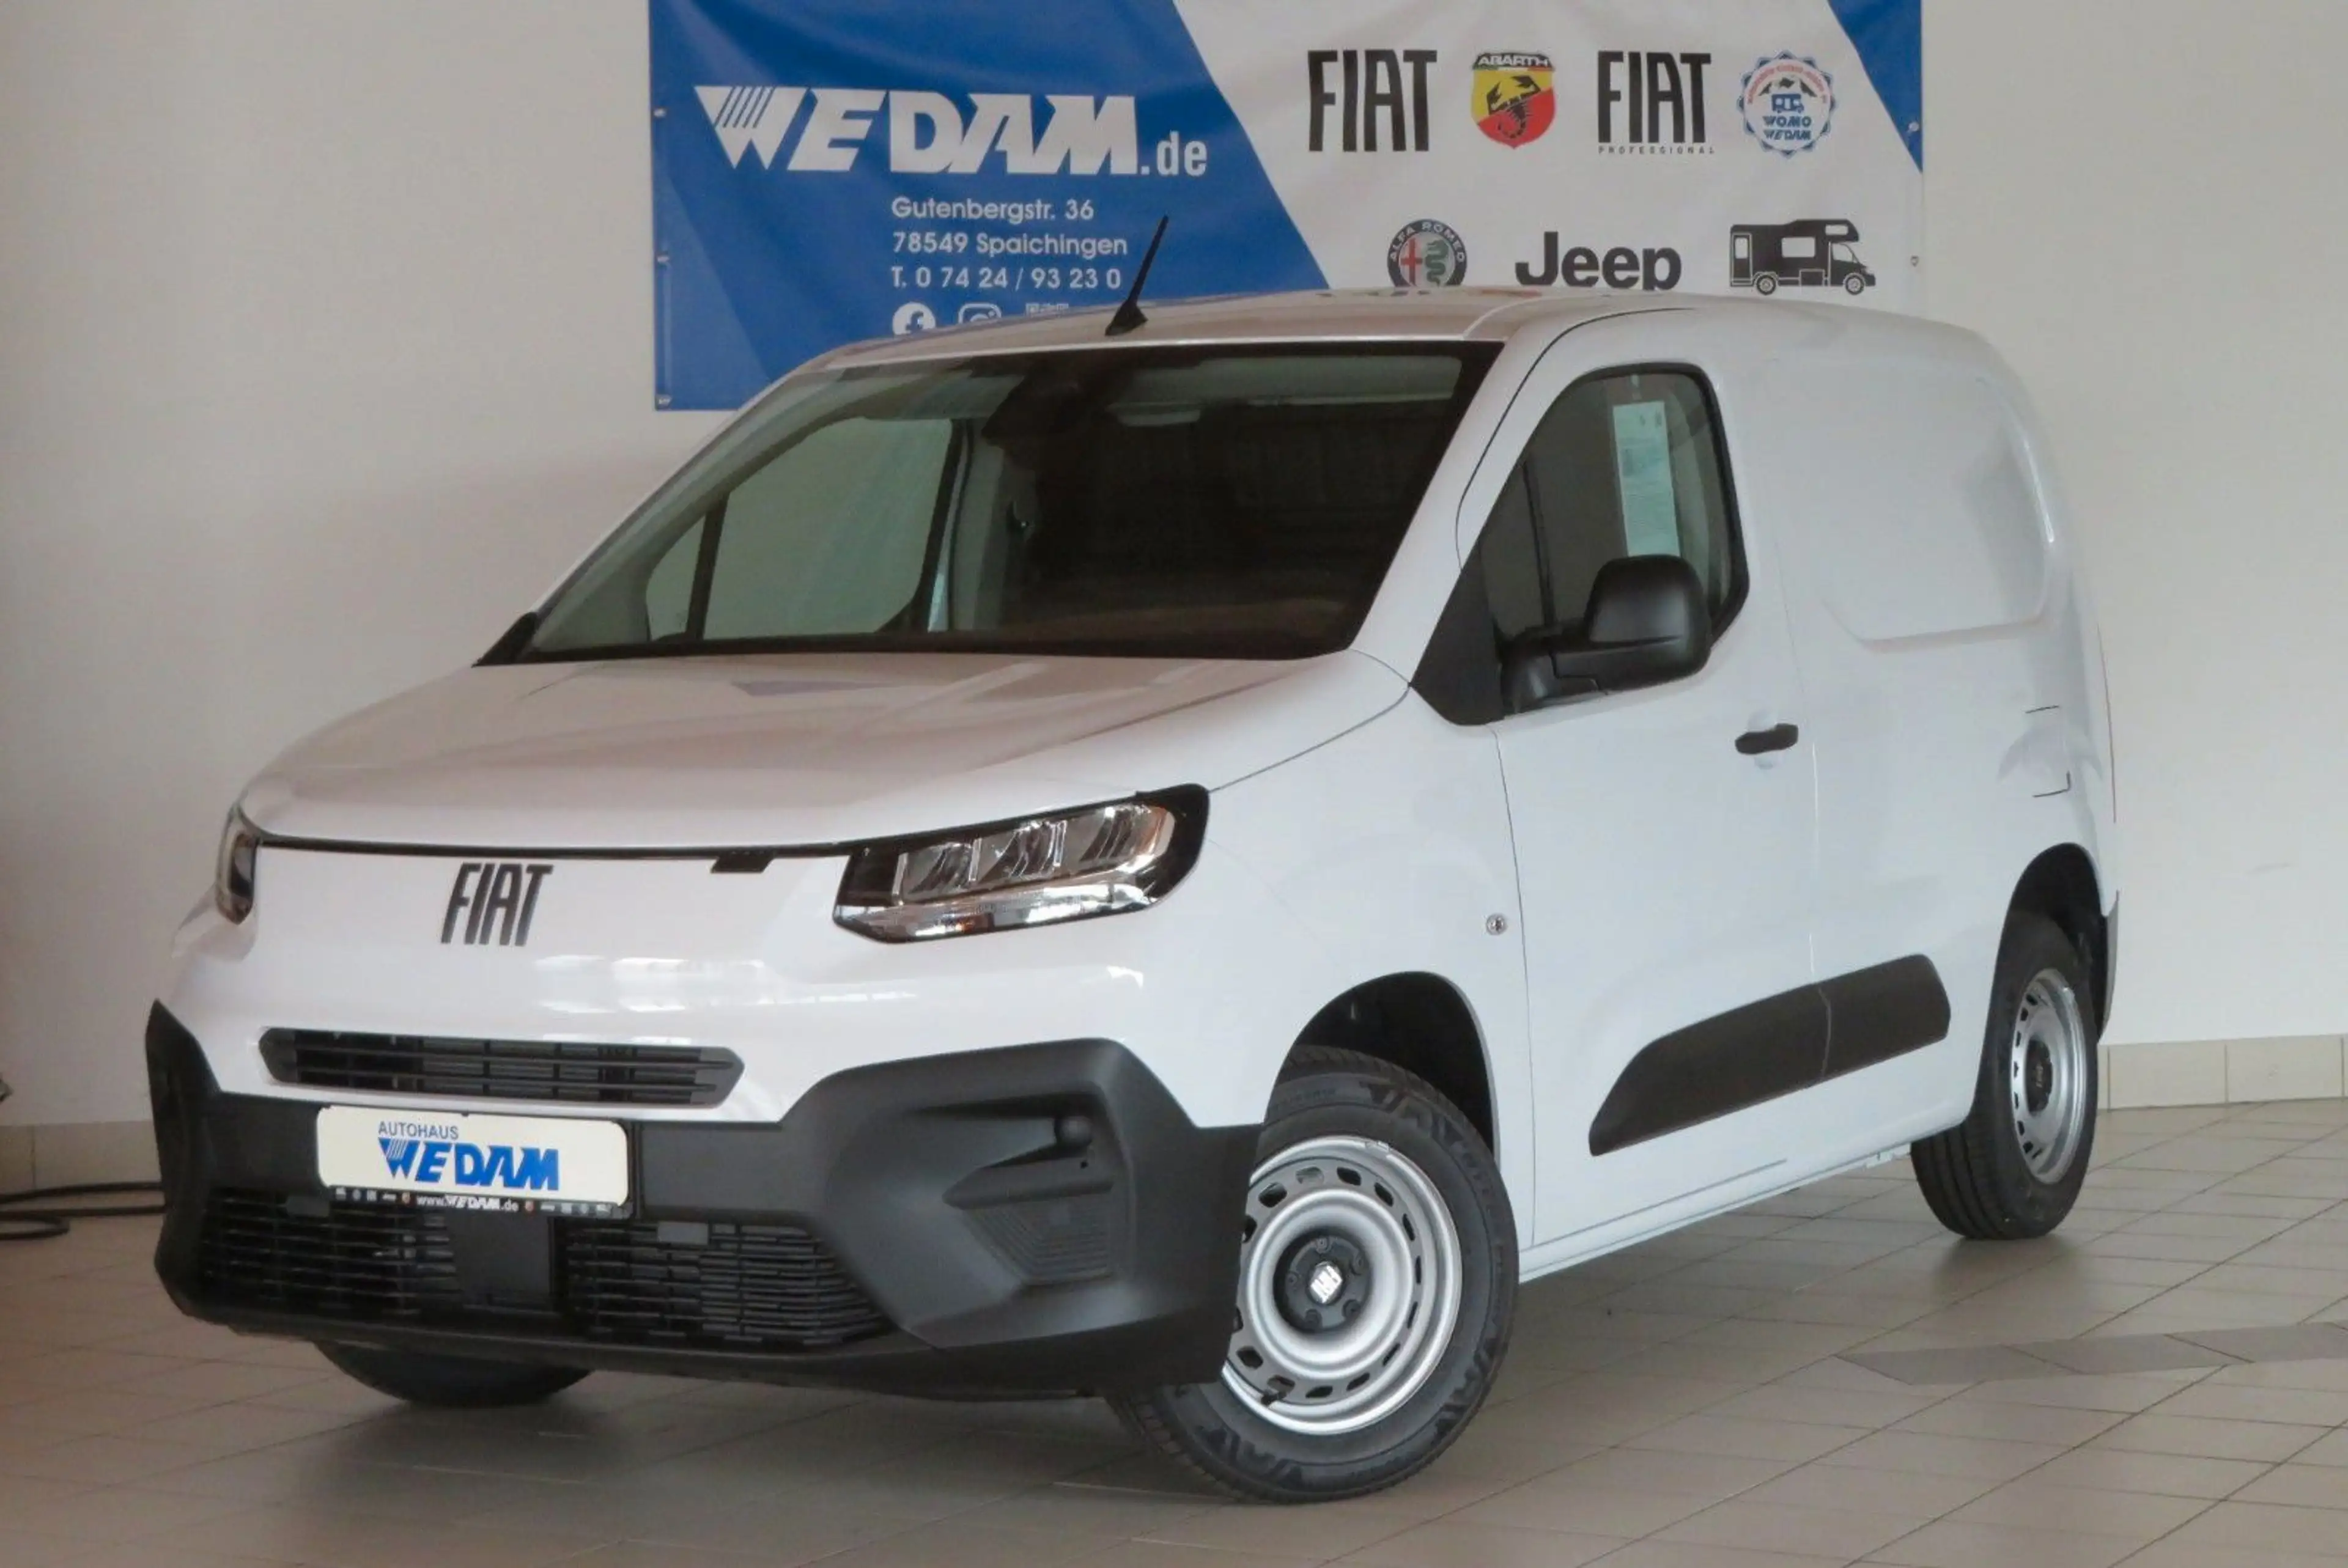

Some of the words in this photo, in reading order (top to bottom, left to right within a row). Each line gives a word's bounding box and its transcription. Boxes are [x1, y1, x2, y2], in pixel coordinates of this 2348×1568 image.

[1477, 54, 1549, 66] ABARTH
[1307, 50, 1438, 152] FIAT
[1598, 51, 1711, 143] FIAT
[1762, 116, 1812, 127] WOMO
[1598, 145, 1715, 155] PROFESSIONAL
[891, 196, 1055, 224] Gutenbergstr.
[1065, 199, 1094, 221] 36
[893, 232, 969, 253] 78549
[976, 233, 1128, 259] Spaichingen
[1390, 226, 1416, 262] ALFA
[1422, 221, 1465, 263] ROMEO
[1515, 231, 1682, 290] Jeep
[892, 266, 907, 288] T.
[917, 267, 931, 288] 0
[941, 267, 970, 288] 74
[978, 267, 1008, 289] 24
[1031, 268, 1060, 289] 93
[1069, 268, 1099, 289] 23
[1106, 268, 1121, 290] 0
[441, 863, 553, 946] FIAT
[378, 1121, 459, 1140] AUTOHAUS
[378, 1137, 559, 1191] WEDAM
[416, 1193, 520, 1213] www.WEDAM.de
